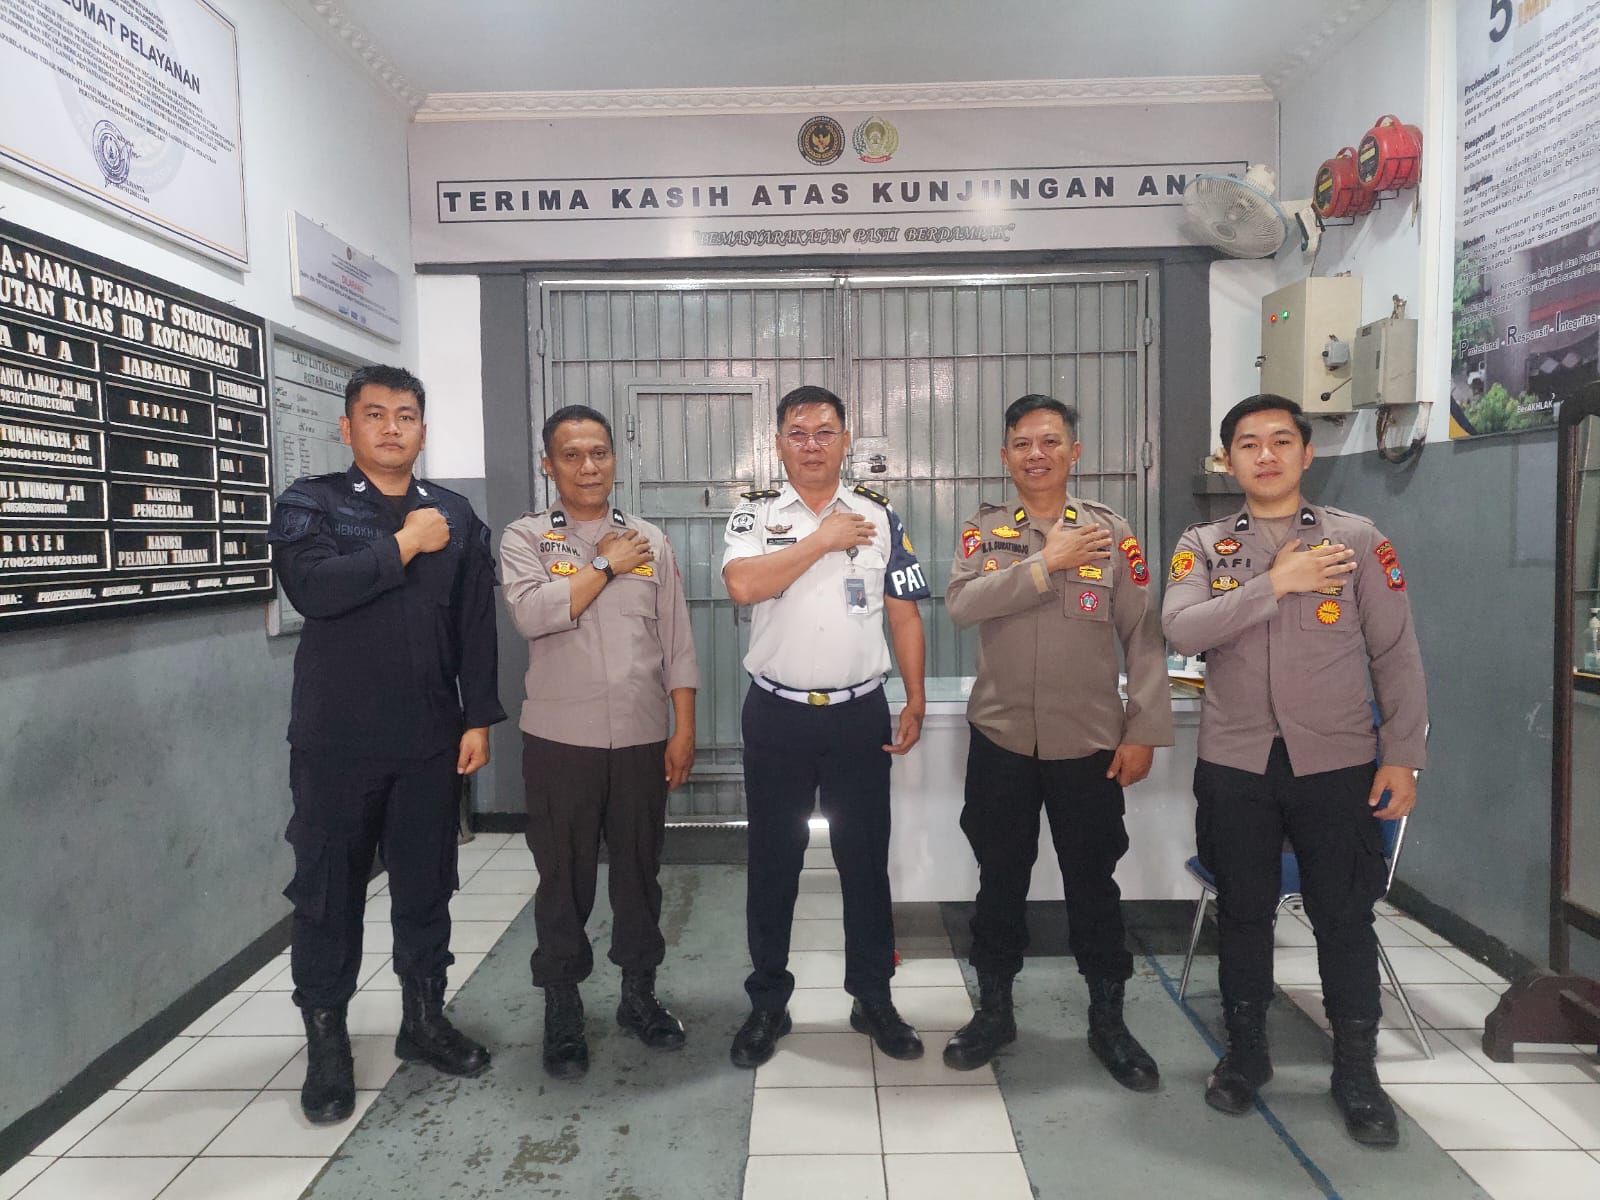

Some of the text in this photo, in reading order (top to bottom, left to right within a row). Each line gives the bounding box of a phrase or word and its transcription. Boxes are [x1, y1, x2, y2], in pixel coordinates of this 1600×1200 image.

[1489, 0, 1513, 43] 5
[62, 0, 200, 94] UMAT PELAYANAN
[443, 174, 1212, 212] TERIMA KASIH ATAS KUNJUNGAN AN
[853, 227, 900, 243] PASTI
[1, 244, 253, 349] A-NAMA PEJABAT STRUKTURAL
[0, 275, 239, 368] UTAN KLAS IIB KOTAMOBAGU
[1507, 325, 1549, 347] Responsif
[1556, 311, 1597, 334] Integritas
[121, 355, 191, 388] JABATAN
[130, 400, 189, 424] KEPALA
[1517, 400, 1553, 413] BerAKHLAK
[132, 503, 194, 518] PENGELOLAAN
[118, 548, 208, 567] PELAYANAN TAHANAN
[891, 564, 926, 596] PAT
